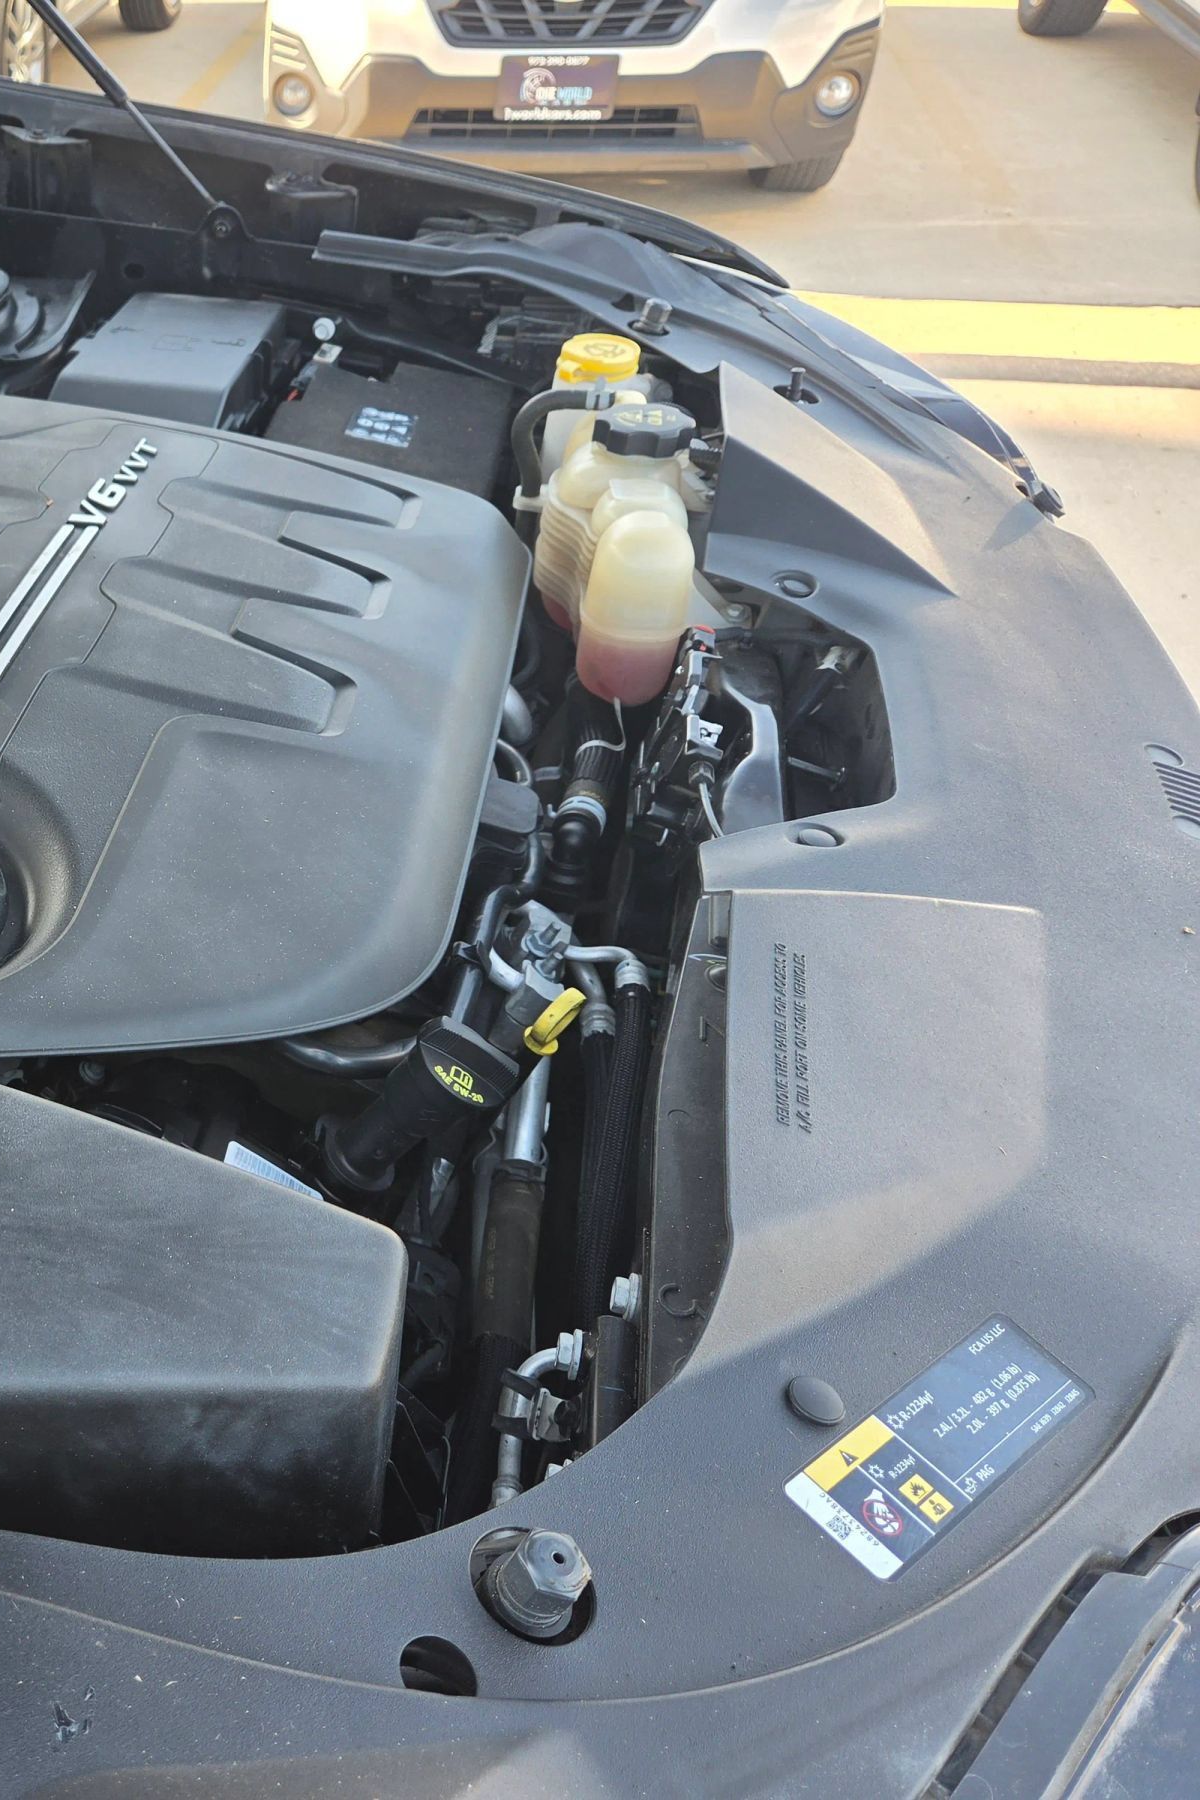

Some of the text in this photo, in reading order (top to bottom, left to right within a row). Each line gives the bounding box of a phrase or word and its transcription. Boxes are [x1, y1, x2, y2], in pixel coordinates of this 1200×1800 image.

[67, 437, 159, 526] V6 VVT
[792, 952, 806, 998] VEHICLES
[793, 1000, 807, 1031] SOME
[773, 942, 790, 1126] REMOVE THIS PANEL FOR ACCESS TO
[794, 1030, 807, 1050] ON
[794, 1050, 809, 1081] PORT
[434, 1065, 484, 1104] SAE 5W-20
[795, 1083, 810, 1107] FILL
[968, 1324, 1005, 1355] FCA US LLC
[899, 1390, 935, 1422] R-1234yf
[951, 1407, 971, 1422] 3.2L
[972, 1391, 989, 1404] 482
[966, 1418, 985, 1434] 2.0L
[986, 1402, 1002, 1416] 397
[976, 1464, 995, 1481] PAG
